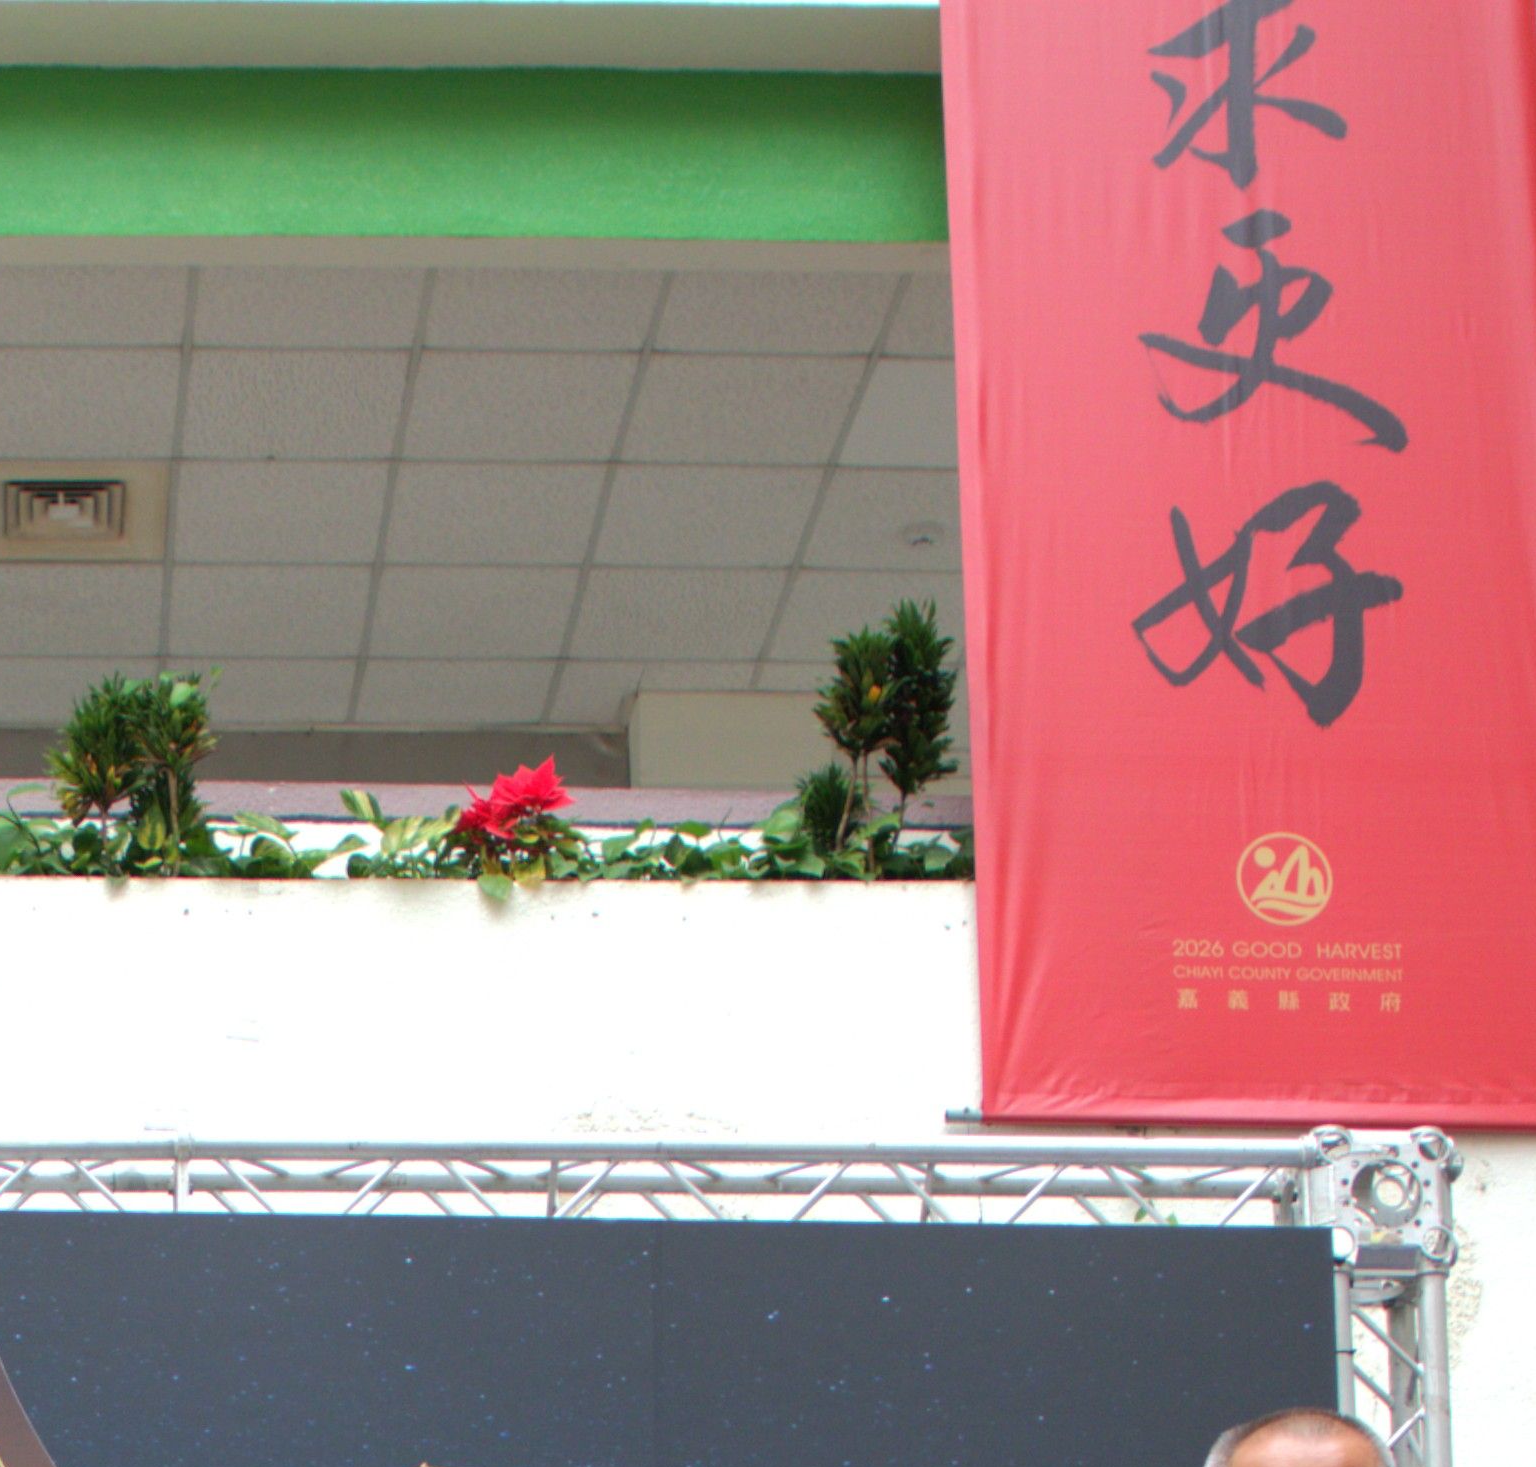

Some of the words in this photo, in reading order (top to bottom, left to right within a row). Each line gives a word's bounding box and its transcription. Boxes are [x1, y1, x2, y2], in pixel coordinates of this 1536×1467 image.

[1172, 939, 1224, 958] 2026
[1232, 941, 1302, 959] GOOD
[1316, 943, 1402, 960] HARVEST
[1173, 965, 1223, 979] CHIAYI
[1229, 966, 1291, 980] COUNTY
[1296, 967, 1403, 982] GOVERNMENT
